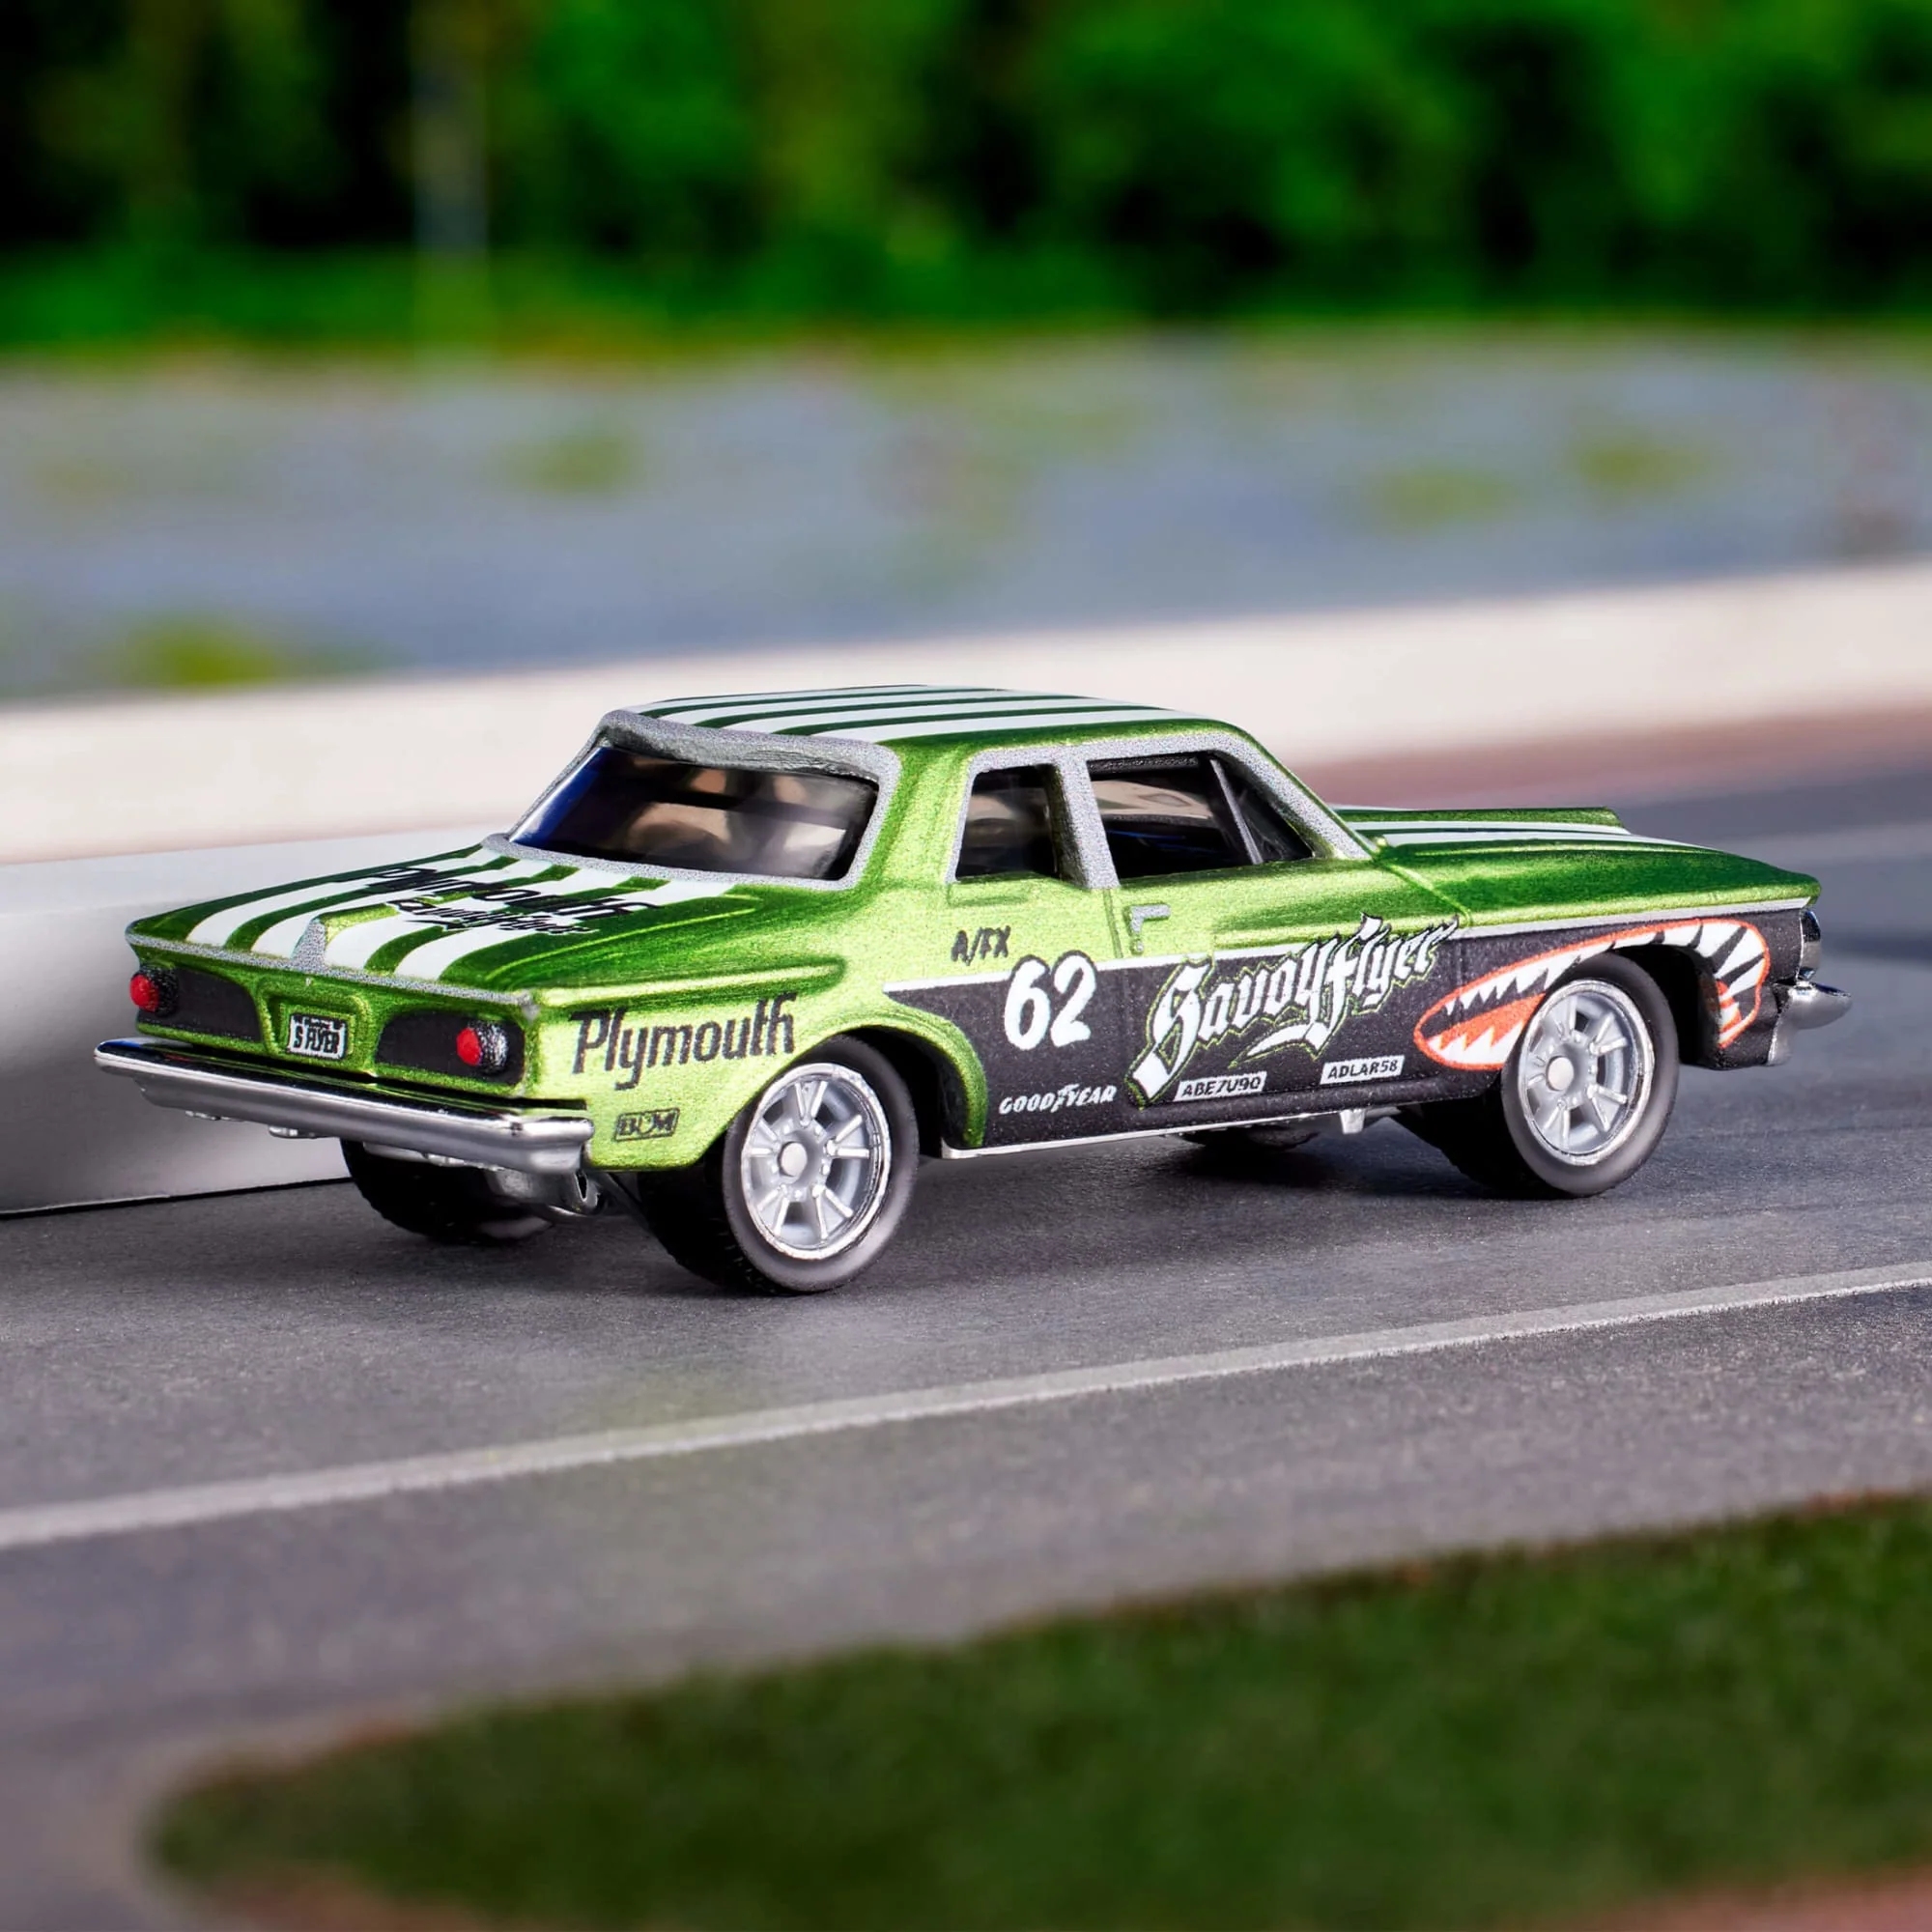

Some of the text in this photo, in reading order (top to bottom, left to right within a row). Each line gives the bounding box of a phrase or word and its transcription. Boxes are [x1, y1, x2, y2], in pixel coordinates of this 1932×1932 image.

[568, 992, 797, 1091] Plymouth
[1005, 950, 1097, 1051] 62
[999, 1083, 1118, 1115] GOODYEAR
